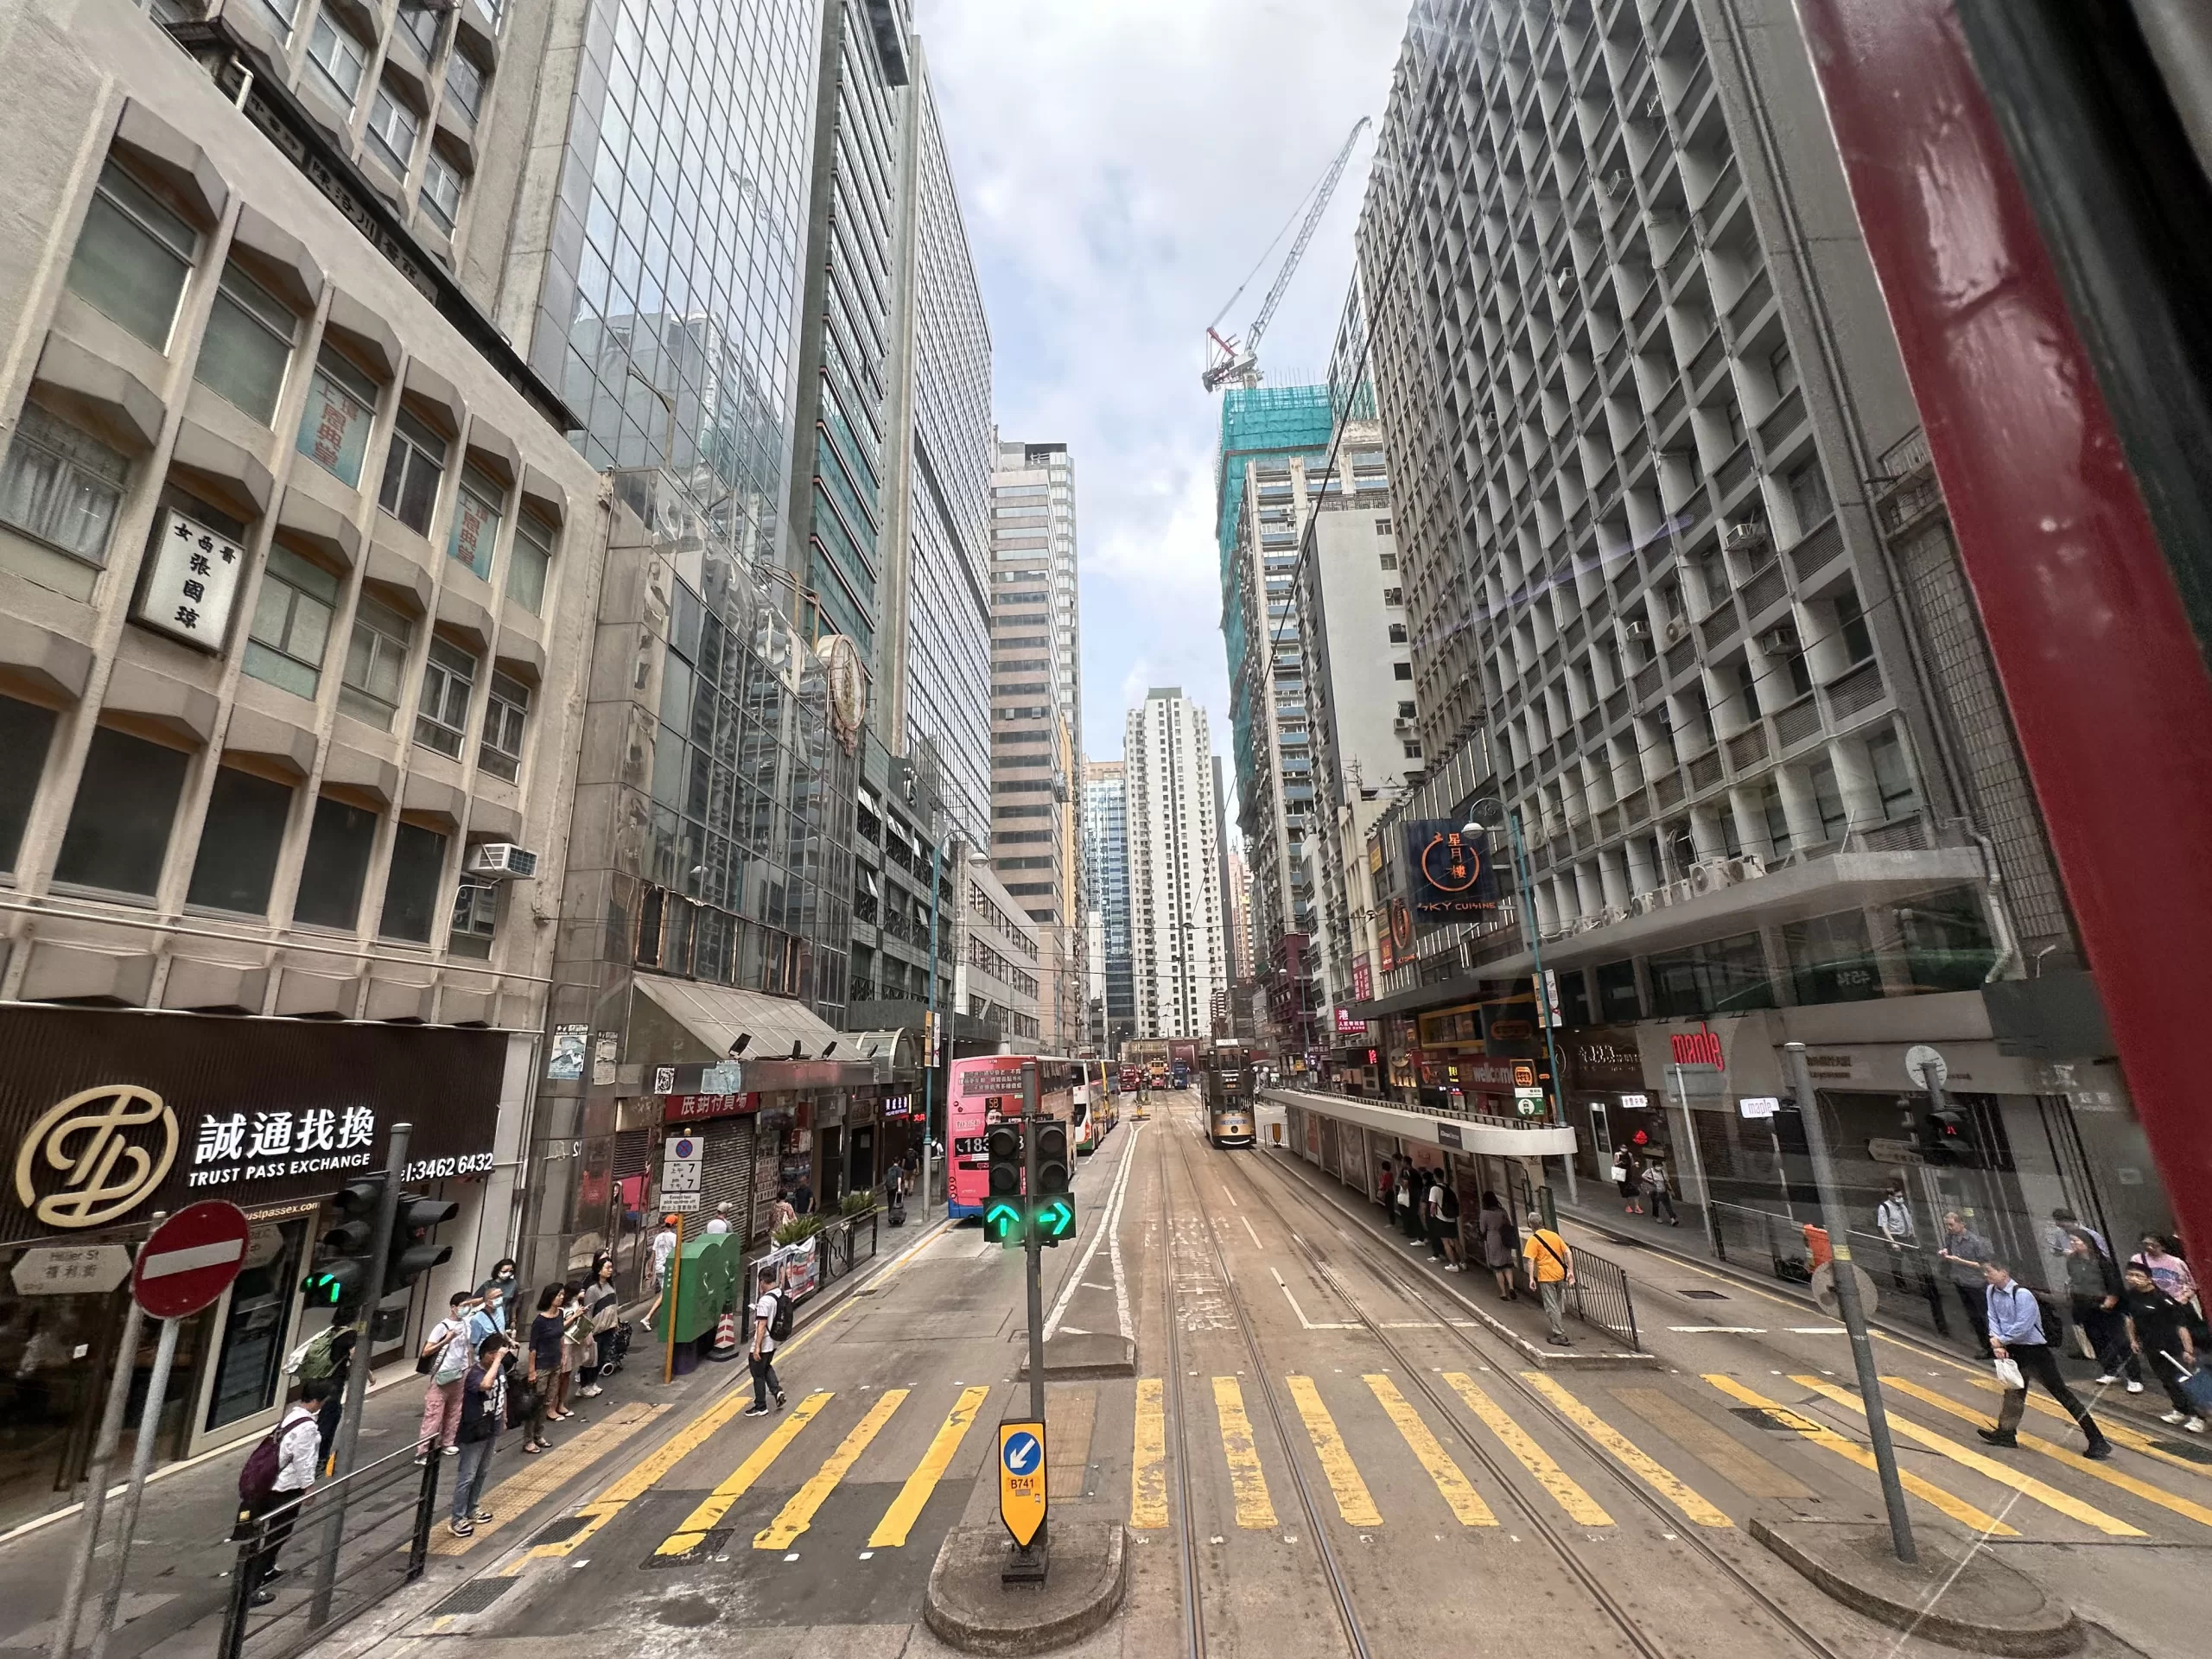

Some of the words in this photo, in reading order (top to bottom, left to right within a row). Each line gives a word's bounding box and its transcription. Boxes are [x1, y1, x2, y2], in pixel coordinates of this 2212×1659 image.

[1455, 902, 1497, 911] CUISINE
[1472, 1063, 1512, 1084] wellcom
[1747, 1099, 1773, 1116] maple
[194, 1106, 375, 1165] 誠通找換
[189, 1167, 240, 1187] TRUST
[245, 1164, 285, 1179] PASS
[290, 1154, 371, 1175] EXCHANGE
[401, 1159, 455, 1182] el:3462
[458, 1153, 493, 1174] 6432
[688, 1163, 696, 1173] 7
[687, 1179, 695, 1189] 7
[247, 1202, 321, 1221] ustpassex.com
[1010, 1478, 1035, 1490] B741
